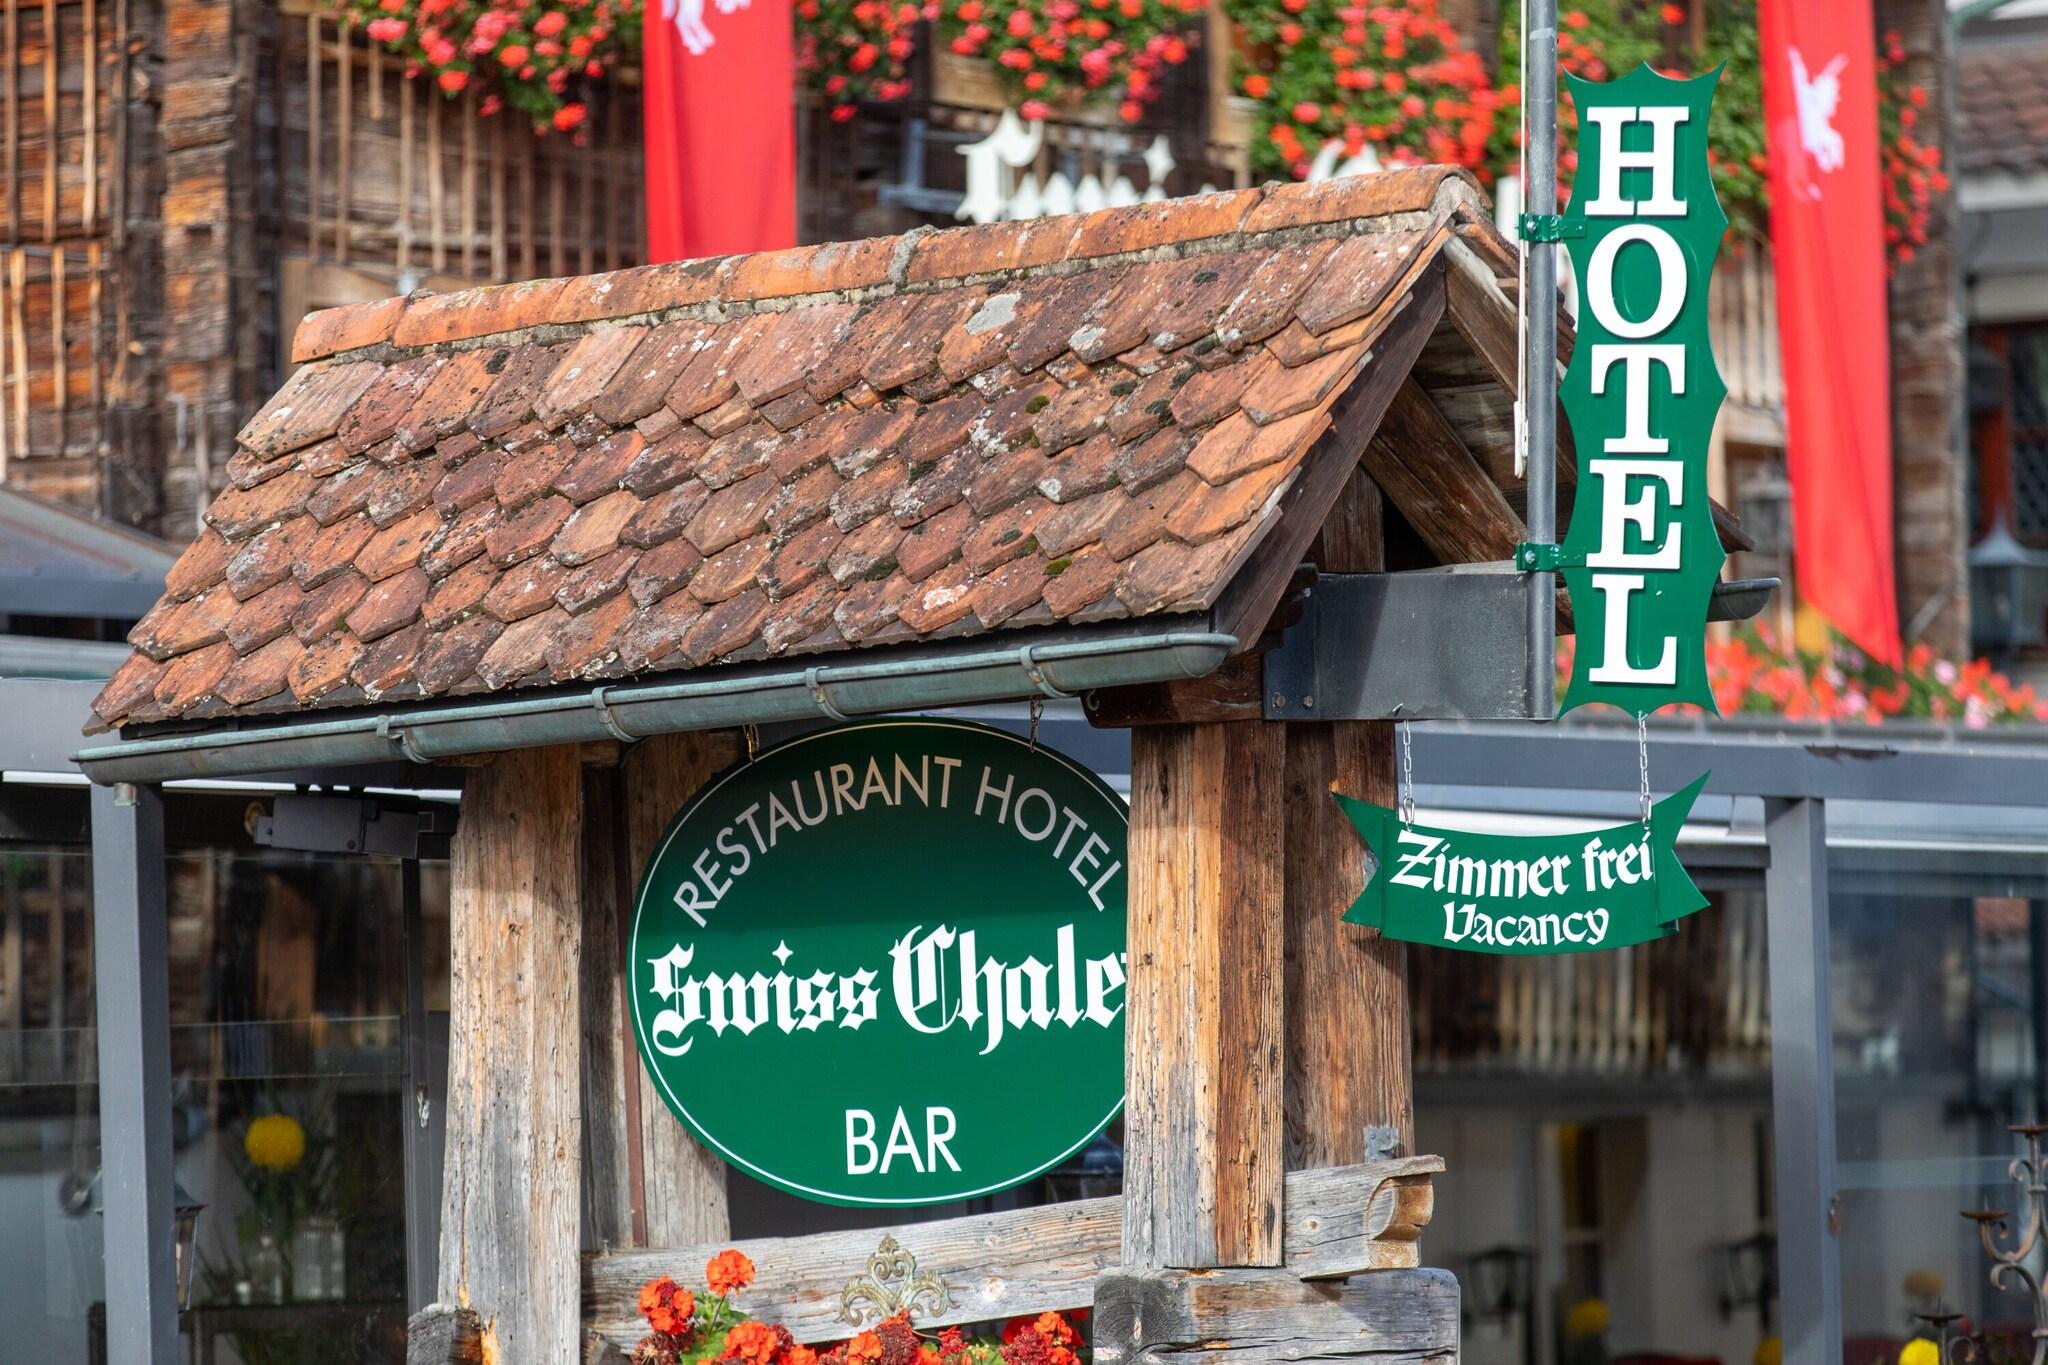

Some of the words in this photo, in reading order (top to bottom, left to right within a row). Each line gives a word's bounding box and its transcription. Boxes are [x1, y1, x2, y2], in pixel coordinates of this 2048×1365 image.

[1584, 105, 1690, 685] HOTEL
[674, 752, 962, 927] RESTAURANT
[974, 766, 1121, 911] HOTEL
[1389, 829, 1571, 899] Zimmer
[1582, 831, 1654, 892] frei
[1442, 901, 1610, 946] Vacancy
[647, 939, 881, 1057] Swiss
[888, 923, 1127, 1055] Chale
[845, 1105, 962, 1175] BAR
